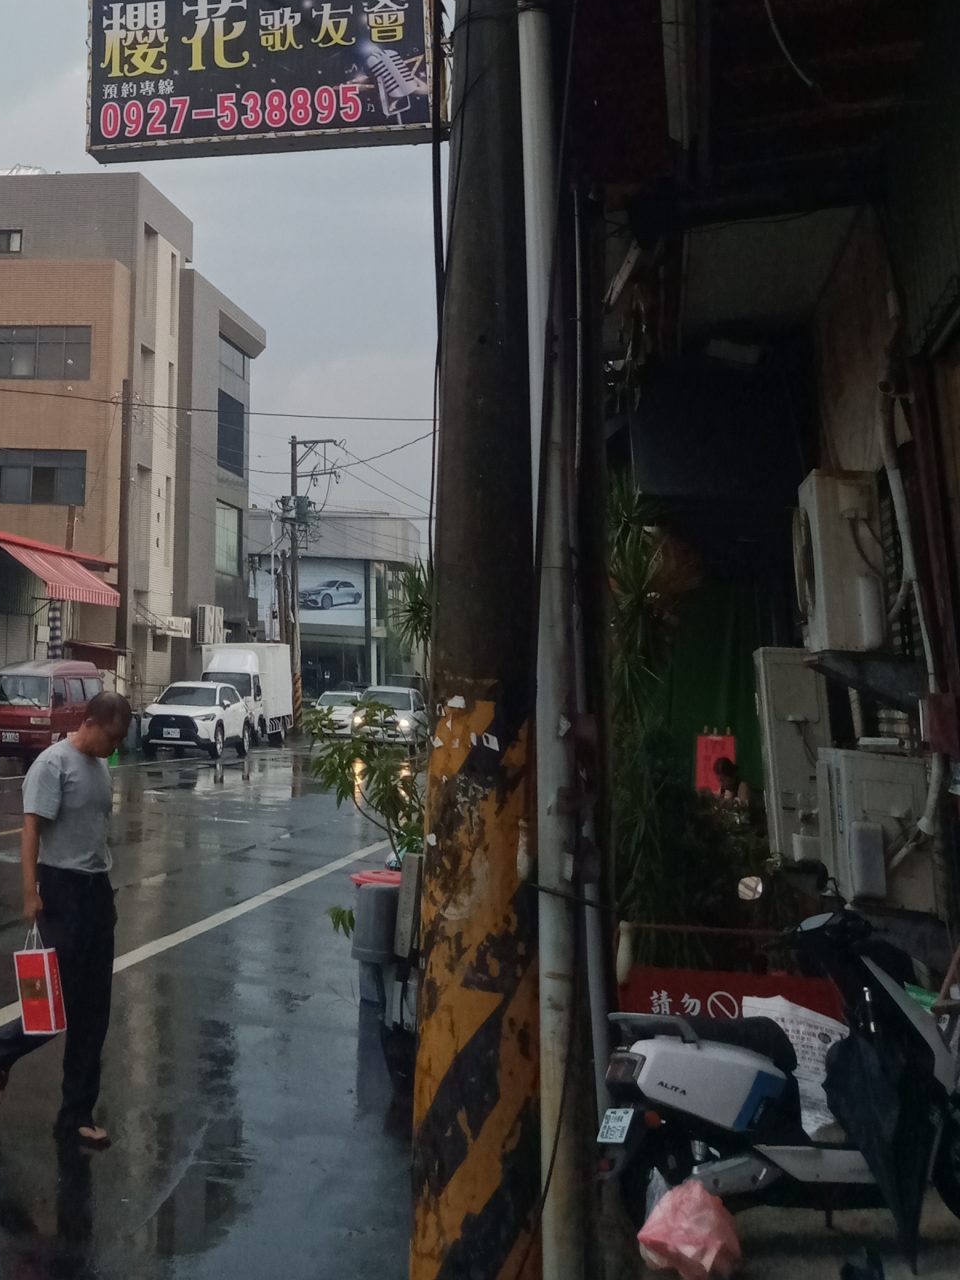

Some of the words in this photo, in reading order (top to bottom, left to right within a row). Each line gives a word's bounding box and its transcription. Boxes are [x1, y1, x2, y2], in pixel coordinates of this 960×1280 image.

[102, 79, 175, 99] 預約專線
[100, 84, 363, 139] 0927-538895
[650, 989, 701, 1017] 請勿
[657, 1080, 687, 1096] ALITA
